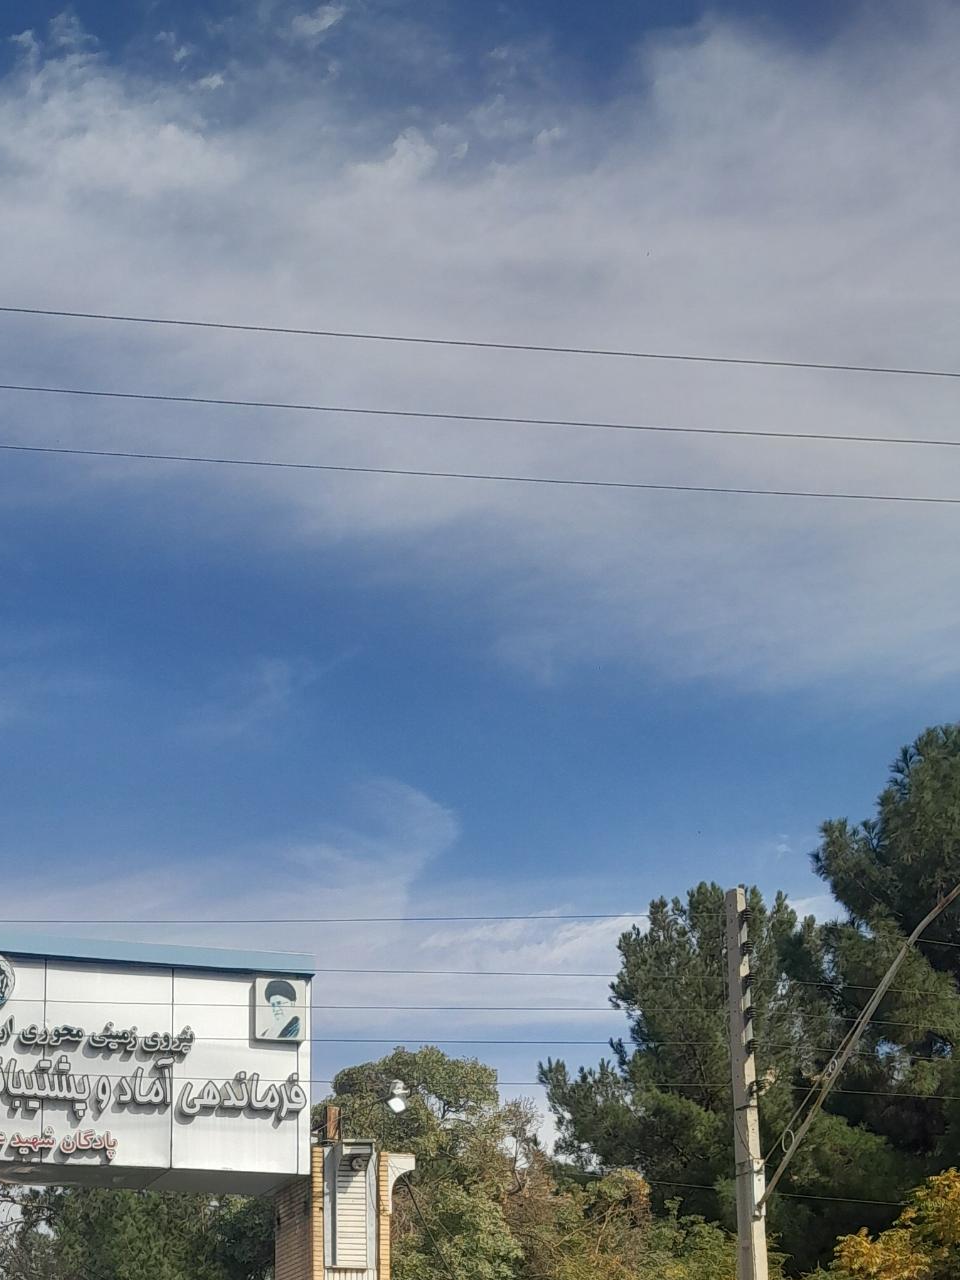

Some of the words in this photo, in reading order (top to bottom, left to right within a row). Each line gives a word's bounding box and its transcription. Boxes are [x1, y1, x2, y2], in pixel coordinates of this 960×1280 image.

[90, 1021, 138, 1051] زمینی
[142, 1025, 195, 1053] نیروی
[97, 1075, 112, 1111] و
[119, 1056, 175, 1105] آماد
[181, 1071, 307, 1119] فرماندهی
[11, 1126, 56, 1156] شهید
[60, 1128, 118, 1160] پادگان
